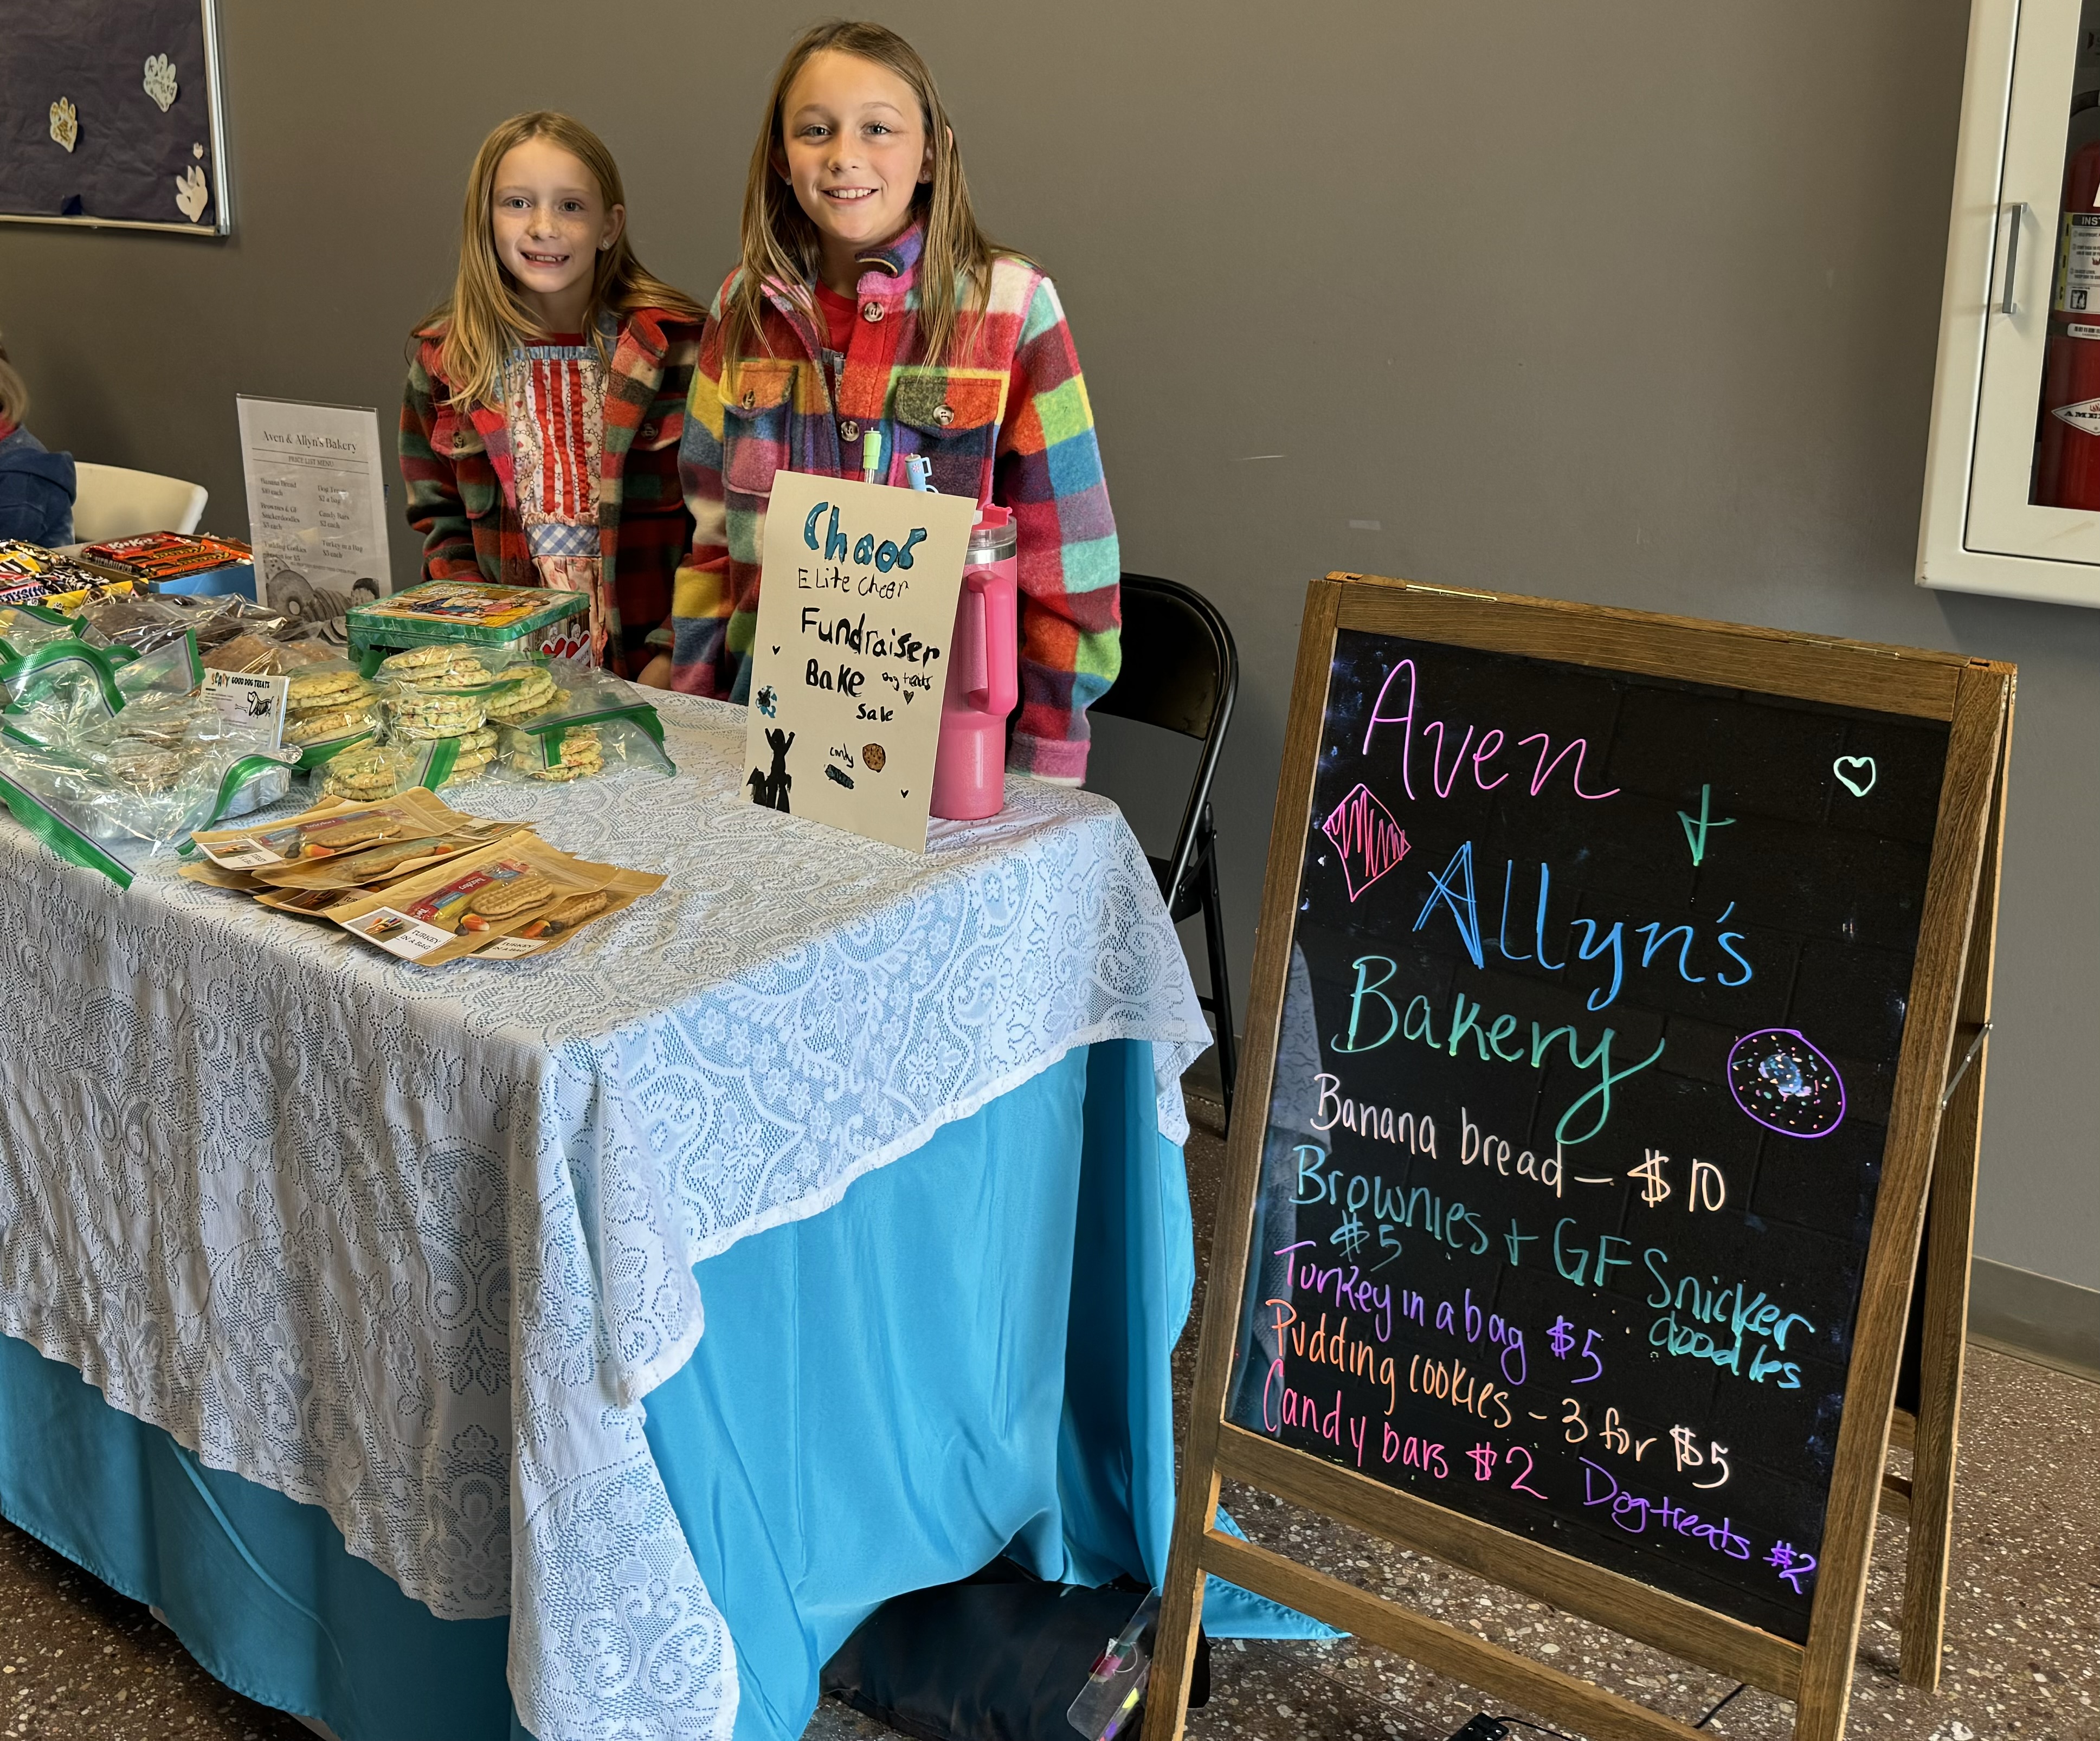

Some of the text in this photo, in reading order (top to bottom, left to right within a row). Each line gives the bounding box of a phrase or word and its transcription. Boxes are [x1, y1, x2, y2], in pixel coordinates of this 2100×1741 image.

[2082, 217, 2100, 225] INS
[263, 431, 357, 454] Aven & Allyn's Bakery
[2064, 411, 2100, 419] AME
[231, 677, 244, 685] GOOD
[244, 679, 253, 687] DOG
[254, 680, 270, 688] TREATS
[802, 607, 940, 668] Fundraiser
[1363, 660, 1620, 800] Aven
[412, 930, 441, 944] TURKEY
[416, 940, 431, 950] BAG
[1412, 841, 1752, 1010] Allyn's
[1331, 955, 1665, 1144] Bakery
[1311, 1073, 1436, 1158] Banana
[1461, 1107, 1562, 1198] bread
[1289, 1145, 1489, 1255] Brownies
[1553, 1217, 1632, 1286] GF
[1644, 1248, 1815, 1351] Snicker
[1330, 1210, 1403, 1271] $5
[1274, 1240, 1603, 1385] Turkey in a bag $5
[1262, 1358, 1548, 1500] Candy bars $2
[1266, 1299, 1396, 1415] Pudding
[1559, 1397, 1588, 1443] 3
[1600, 1408, 1657, 1461] for
[1670, 1424, 1729, 1489] $5
[1579, 1456, 1816, 1595] Dog treats $2
